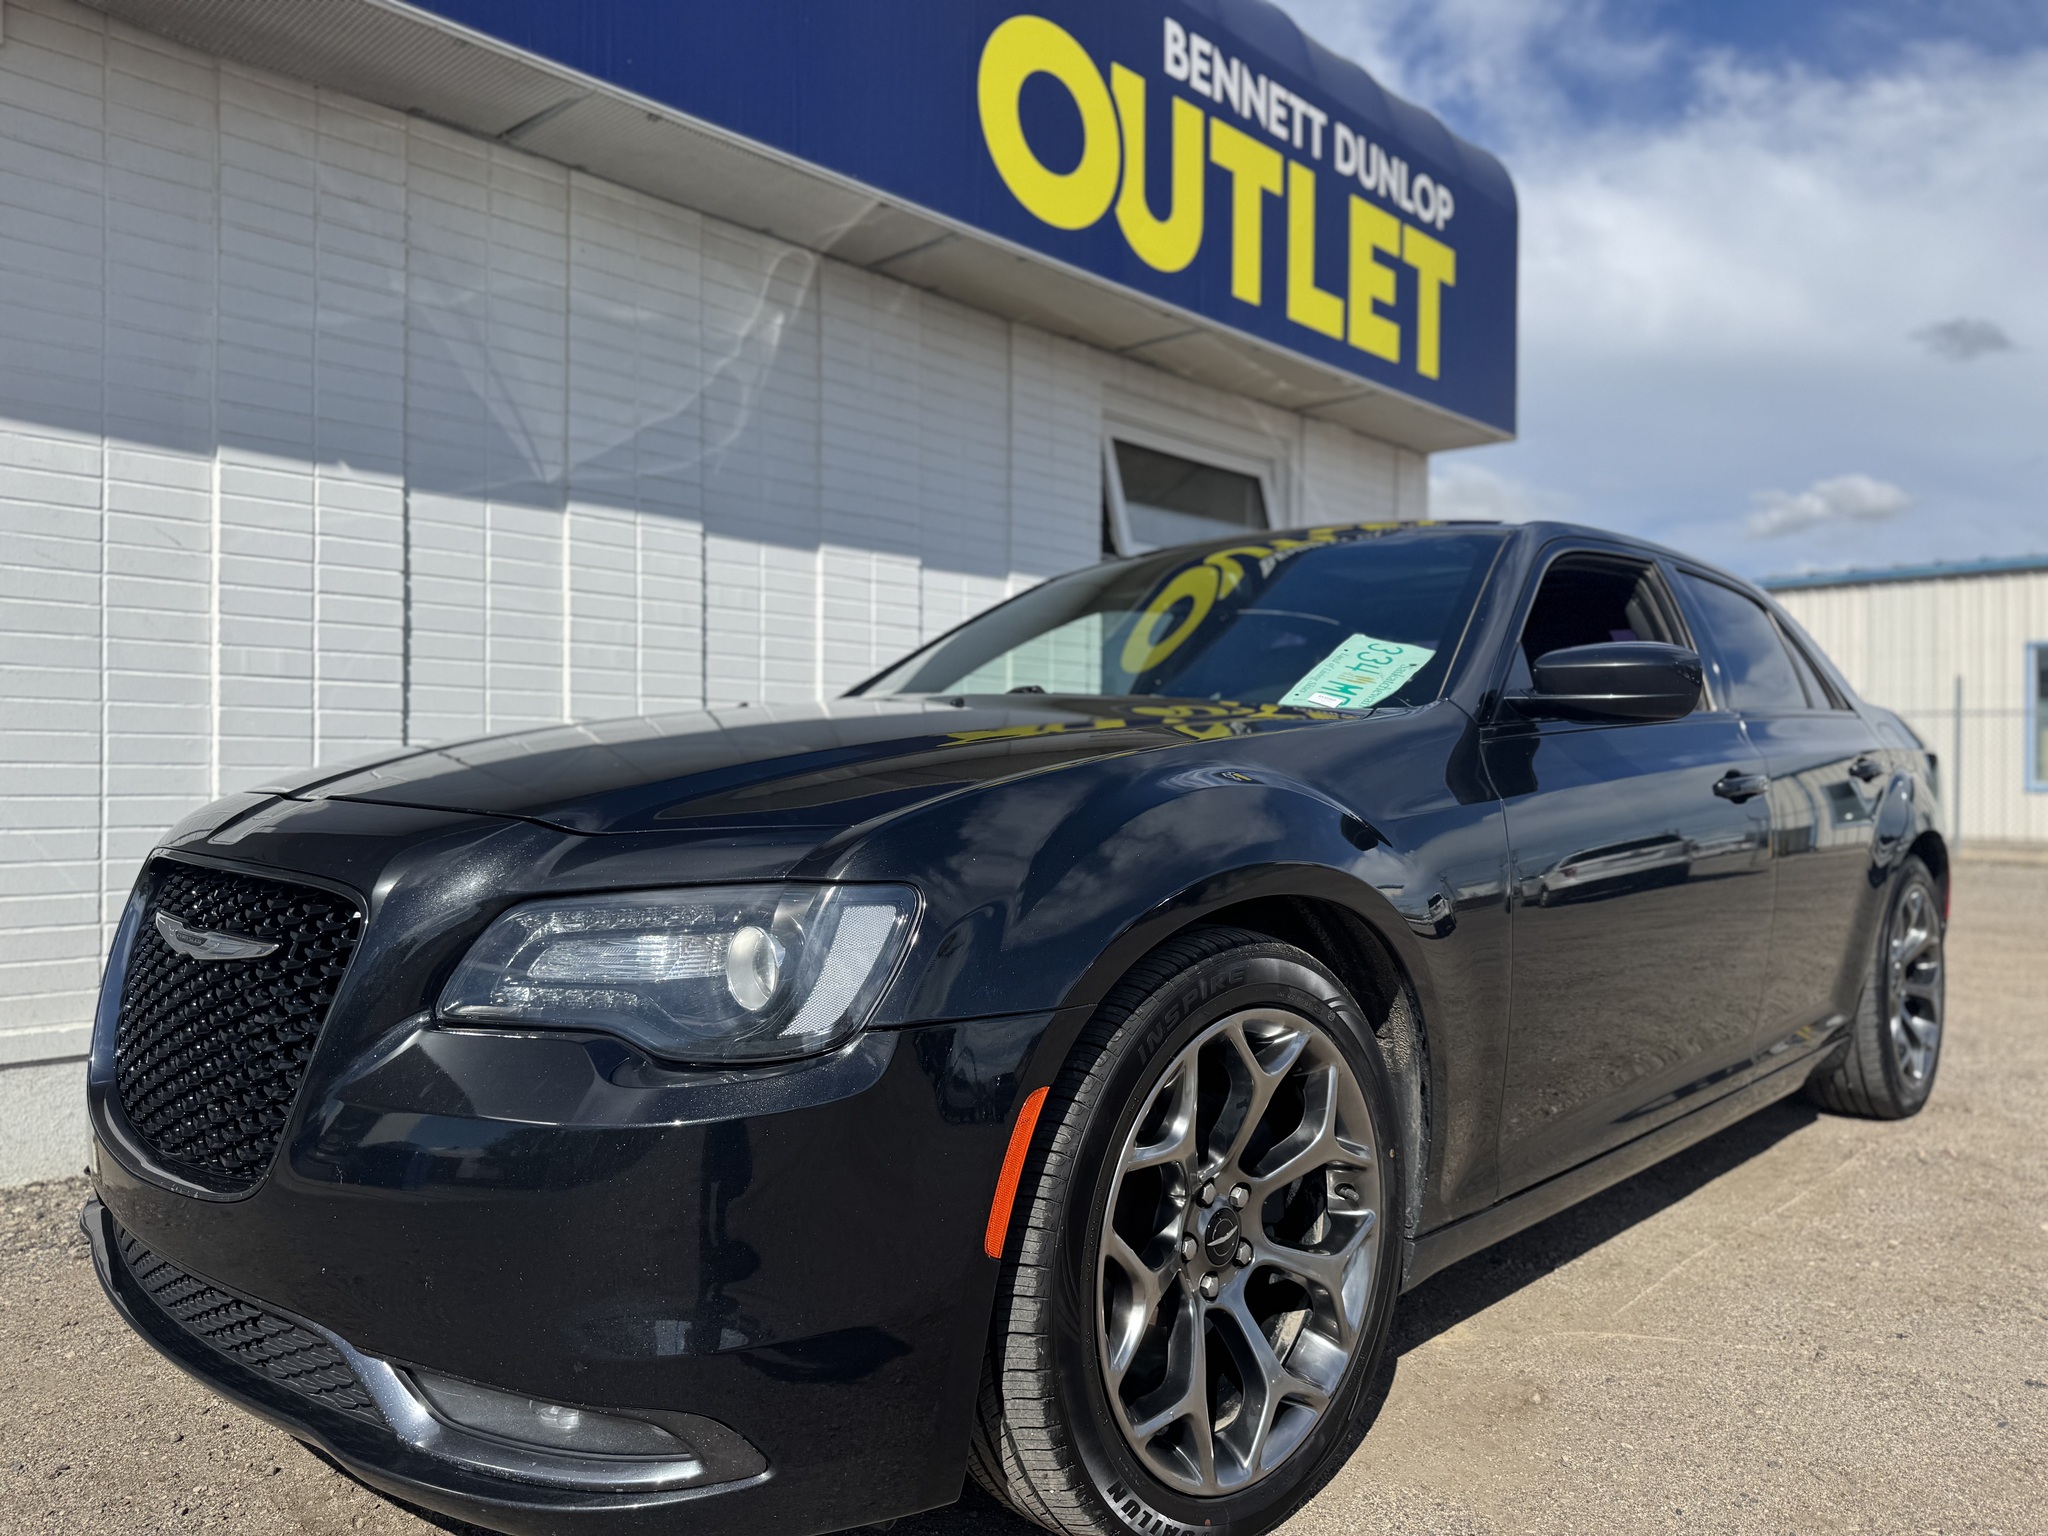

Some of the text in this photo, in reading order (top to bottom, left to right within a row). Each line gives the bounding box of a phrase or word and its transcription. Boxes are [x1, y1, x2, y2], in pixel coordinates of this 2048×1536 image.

[976, 14, 1456, 380] OUTLET
[1163, 16, 1455, 231] BENNETT DUNLOP
[1344, 643, 1404, 675] 334
[1137, 965, 1246, 1065] INSPIRE
